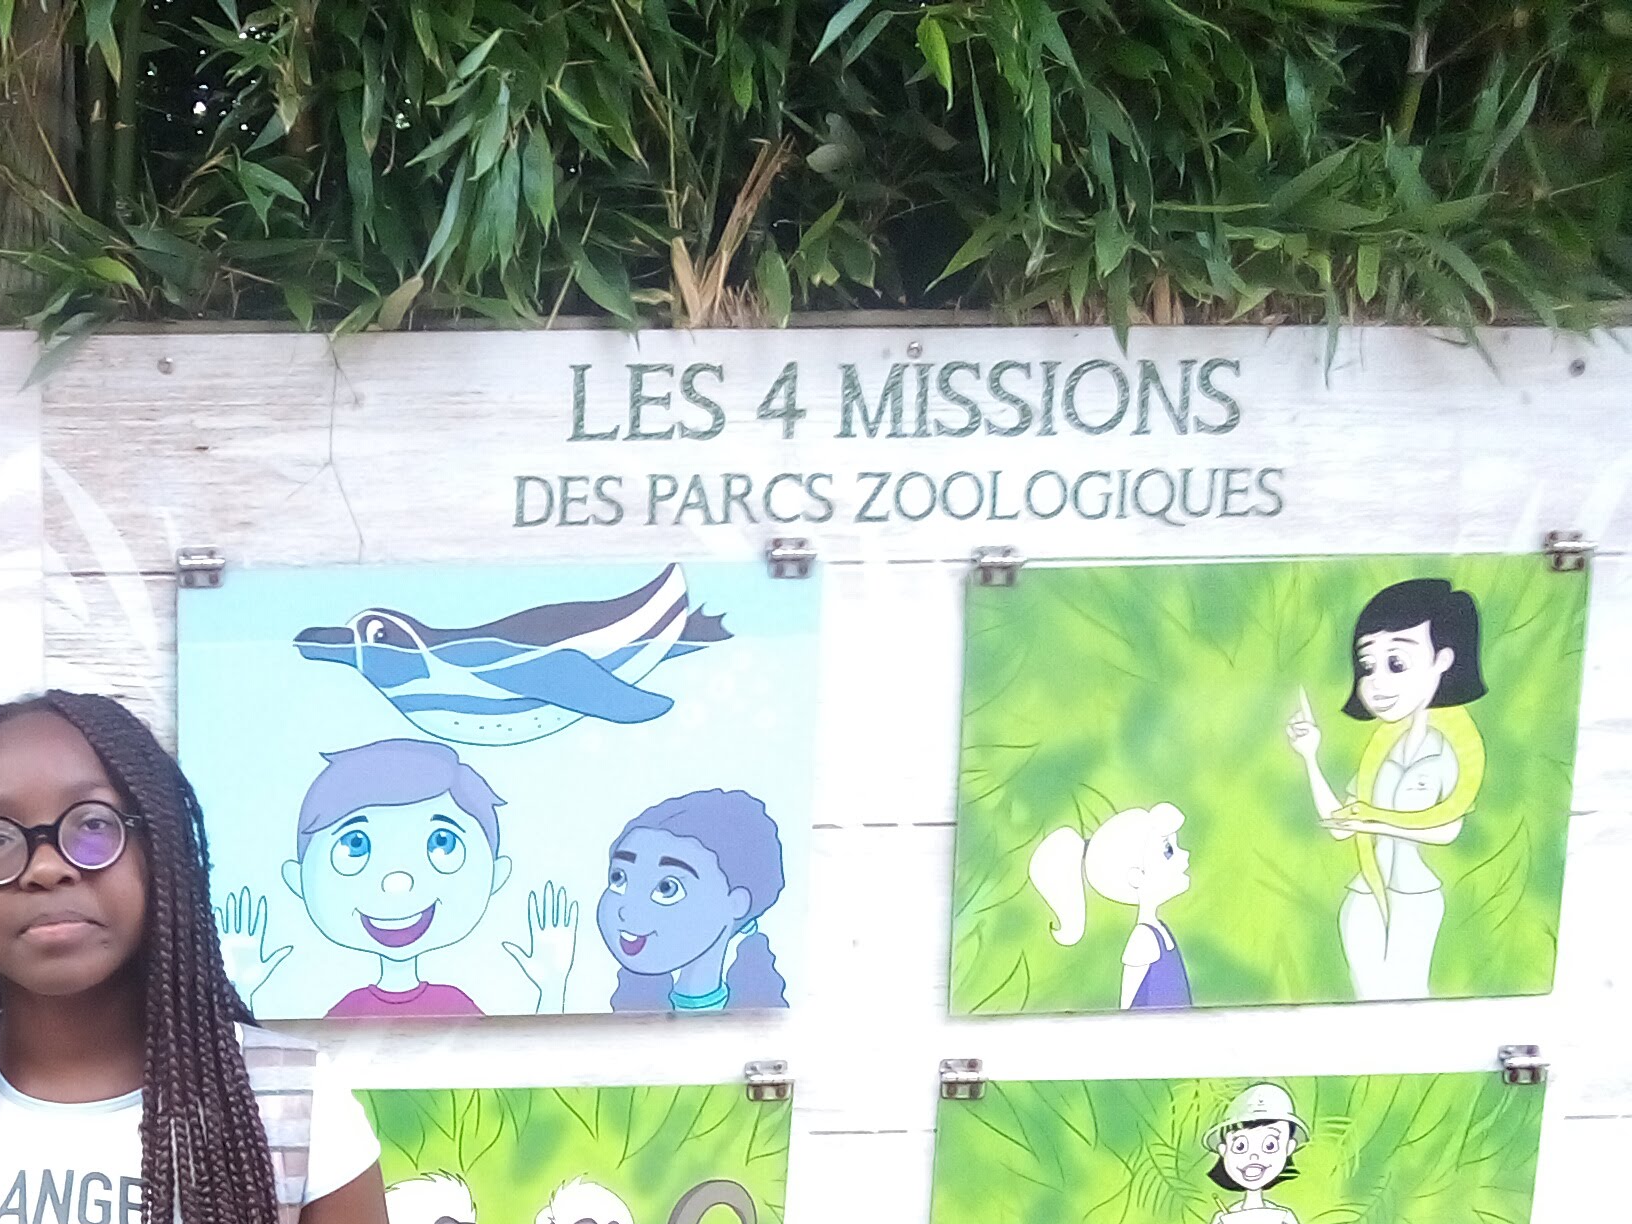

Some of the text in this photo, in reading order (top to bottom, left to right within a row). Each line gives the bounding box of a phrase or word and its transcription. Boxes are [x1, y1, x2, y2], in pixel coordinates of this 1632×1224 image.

[566, 356, 1244, 442] LES 4 MISSIONS
[512, 465, 1285, 528] DES PARCS ZOOLOGIQUES
